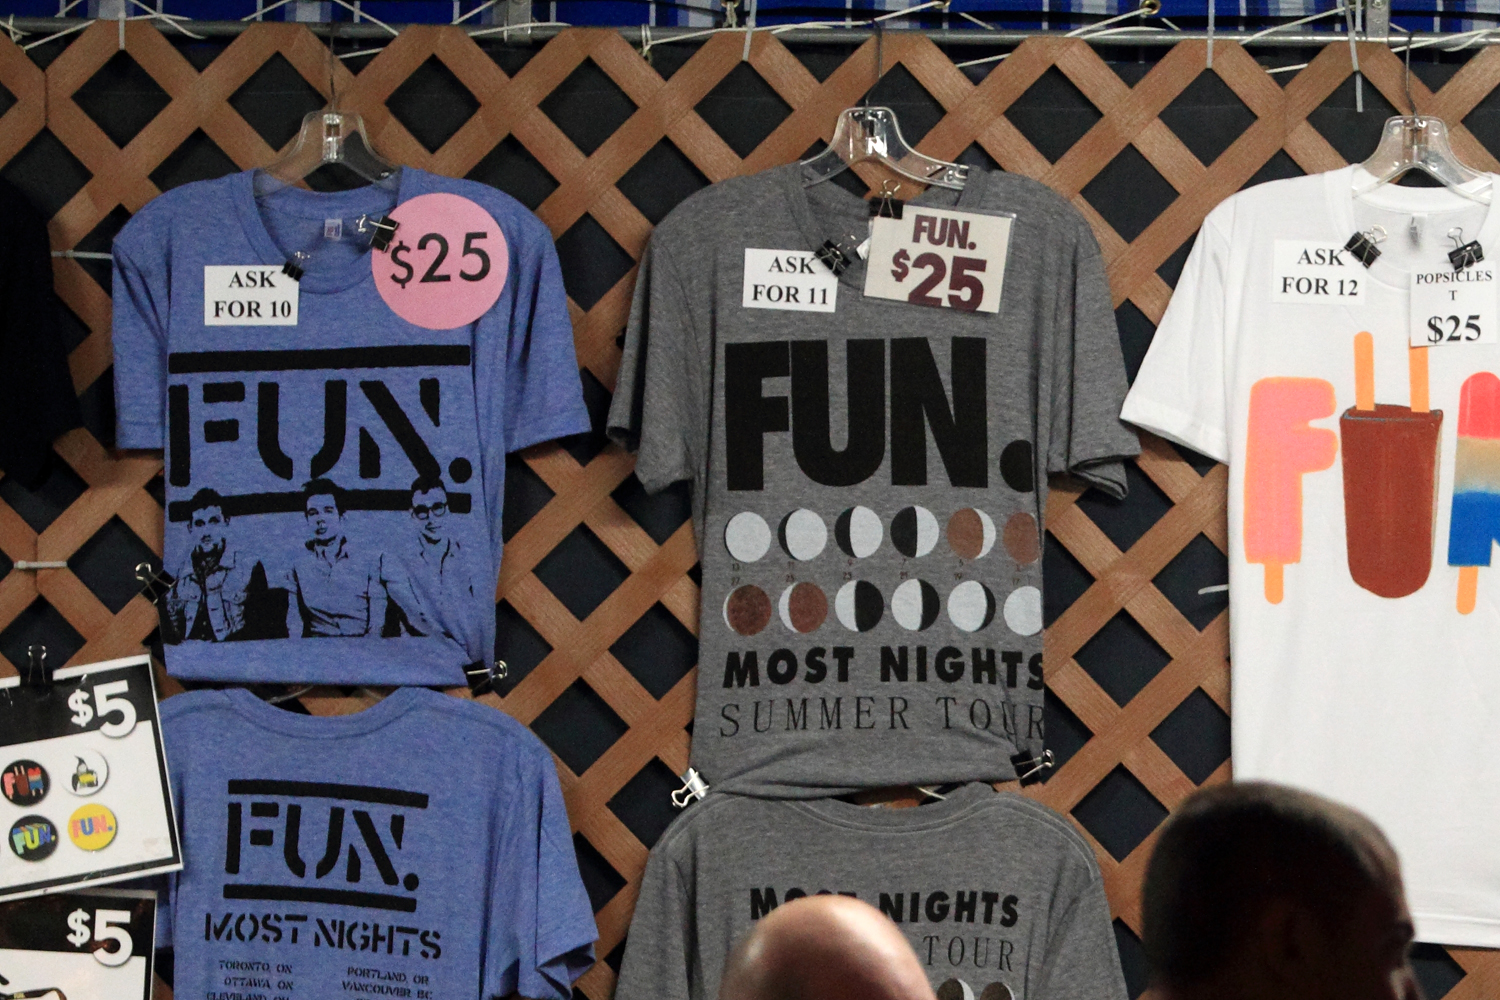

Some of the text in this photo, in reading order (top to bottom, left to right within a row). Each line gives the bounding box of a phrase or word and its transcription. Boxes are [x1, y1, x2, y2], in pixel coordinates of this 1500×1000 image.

[912, 214, 977, 251] FUN.
[389, 231, 492, 290] $25
[768, 256, 817, 275] ASK
[1297, 248, 1345, 267] ASK
[228, 270, 277, 289] ASK
[890, 248, 988, 313] $25
[1281, 276, 1359, 297] FOR 12
[1416, 269, 1493, 285] POPSICLES
[213, 299, 292, 319] FOR 10
[752, 284, 829, 305] FOR 11
[1448, 289, 1458, 301] T
[1427, 314, 1482, 344] $25
[724, 337, 1033, 493] FUN.
[168, 377, 473, 487] FUN.
[722, 645, 1044, 691] MOST NIGHTS
[67, 679, 137, 739] $5
[720, 696, 1044, 742] SUMMER TOUR
[71, 814, 113, 839] FUN.
[225, 802, 419, 891] FUN.
[879, 890, 1019, 928] NIGHTS
[66, 908, 133, 967] $5
[204, 913, 442, 960] MOST NIGHTS
[276, 963, 293, 974] ON
[923, 935, 1014, 972] TOUR
[277, 980, 294, 991] ON
[413, 974, 429, 985] OR
[417, 989, 433, 1000] BC
